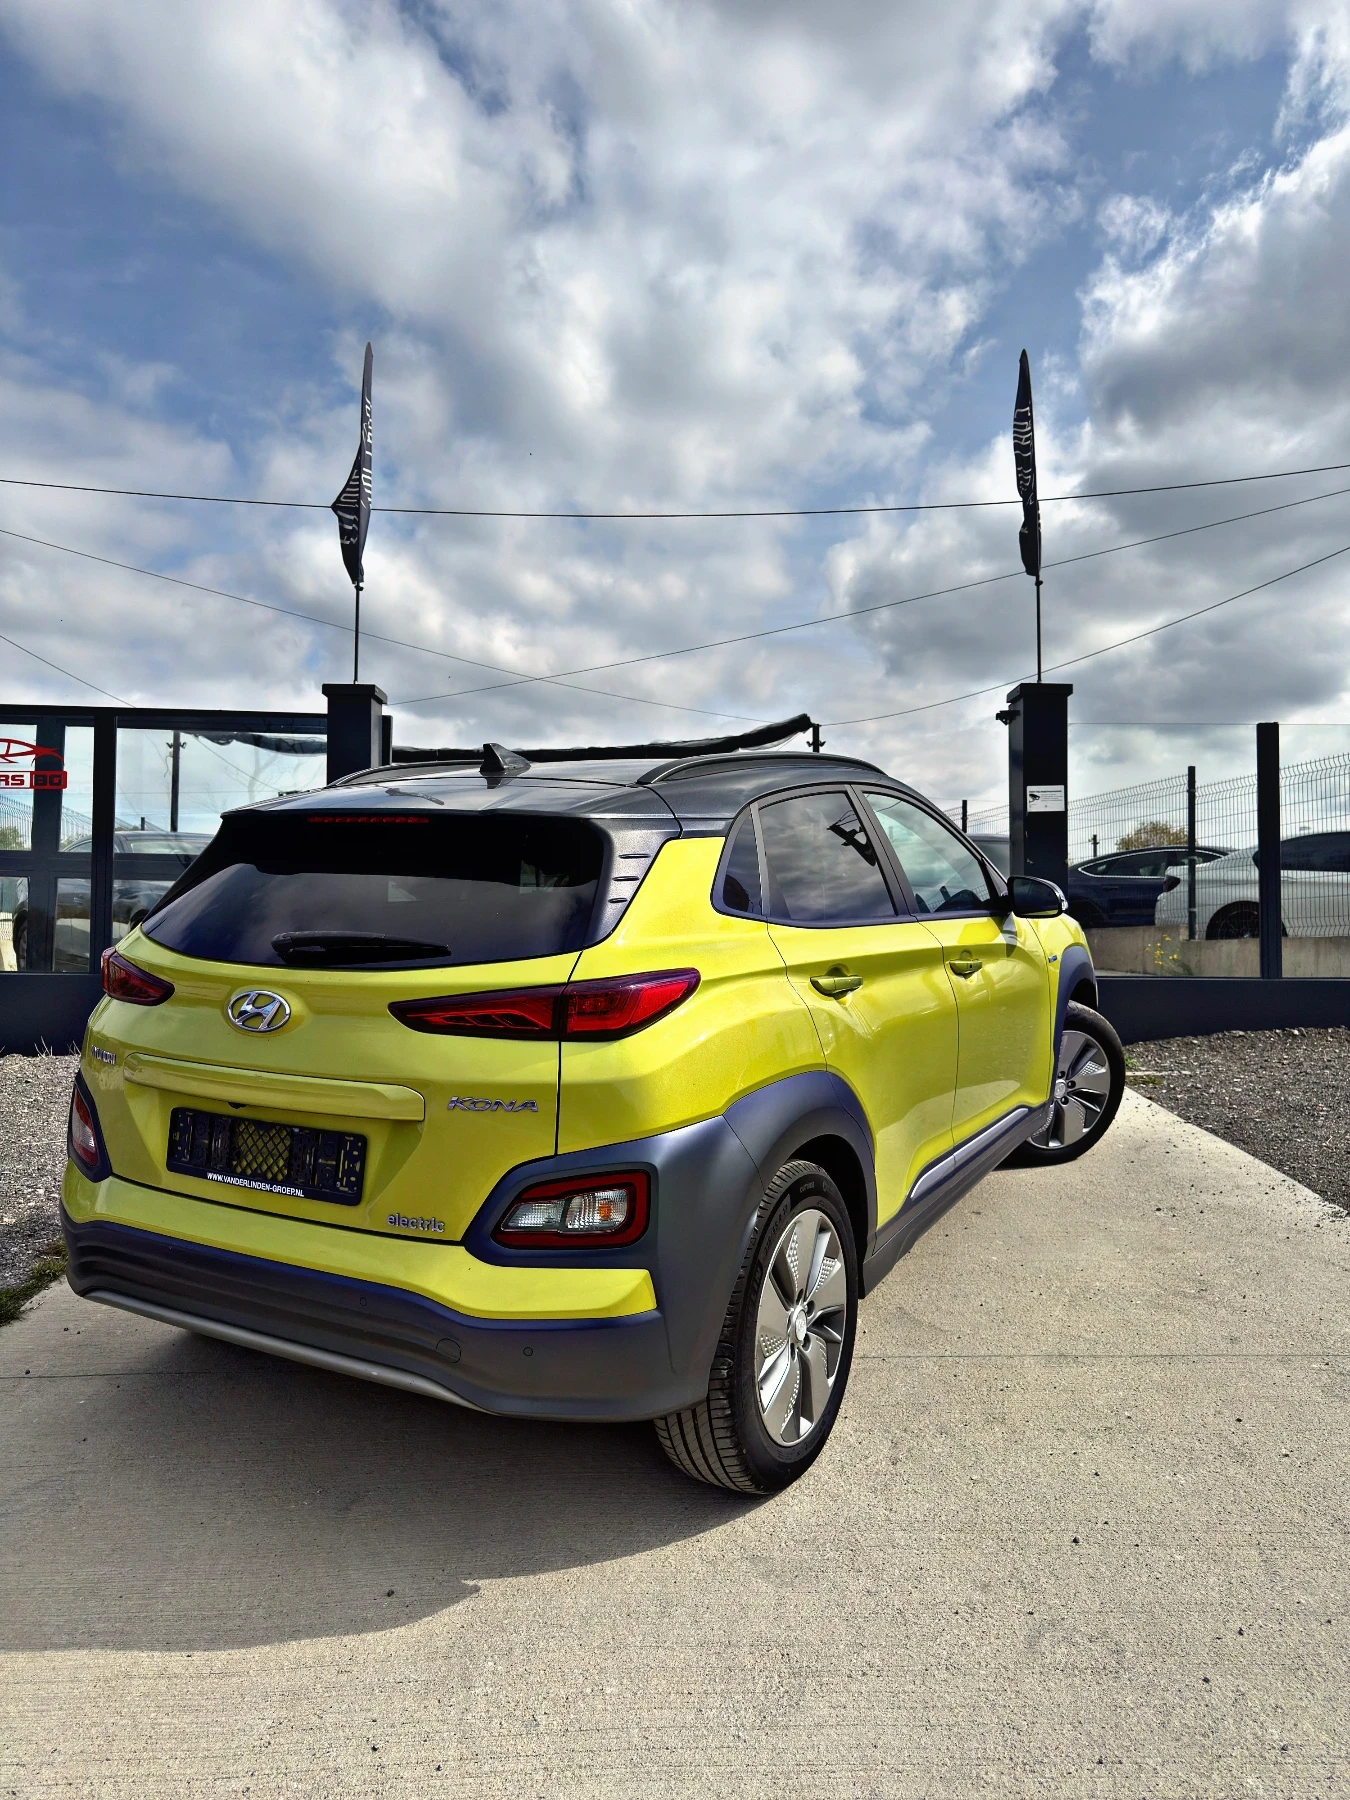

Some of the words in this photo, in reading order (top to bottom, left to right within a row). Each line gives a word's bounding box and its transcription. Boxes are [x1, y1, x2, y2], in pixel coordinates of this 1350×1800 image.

[34, 774, 63, 786] BG
[447, 1096, 538, 1112] KONA
[206, 1171, 305, 1198] WWW.VANDERLINDEN-GROEP.NL
[386, 1213, 445, 1233] electric
